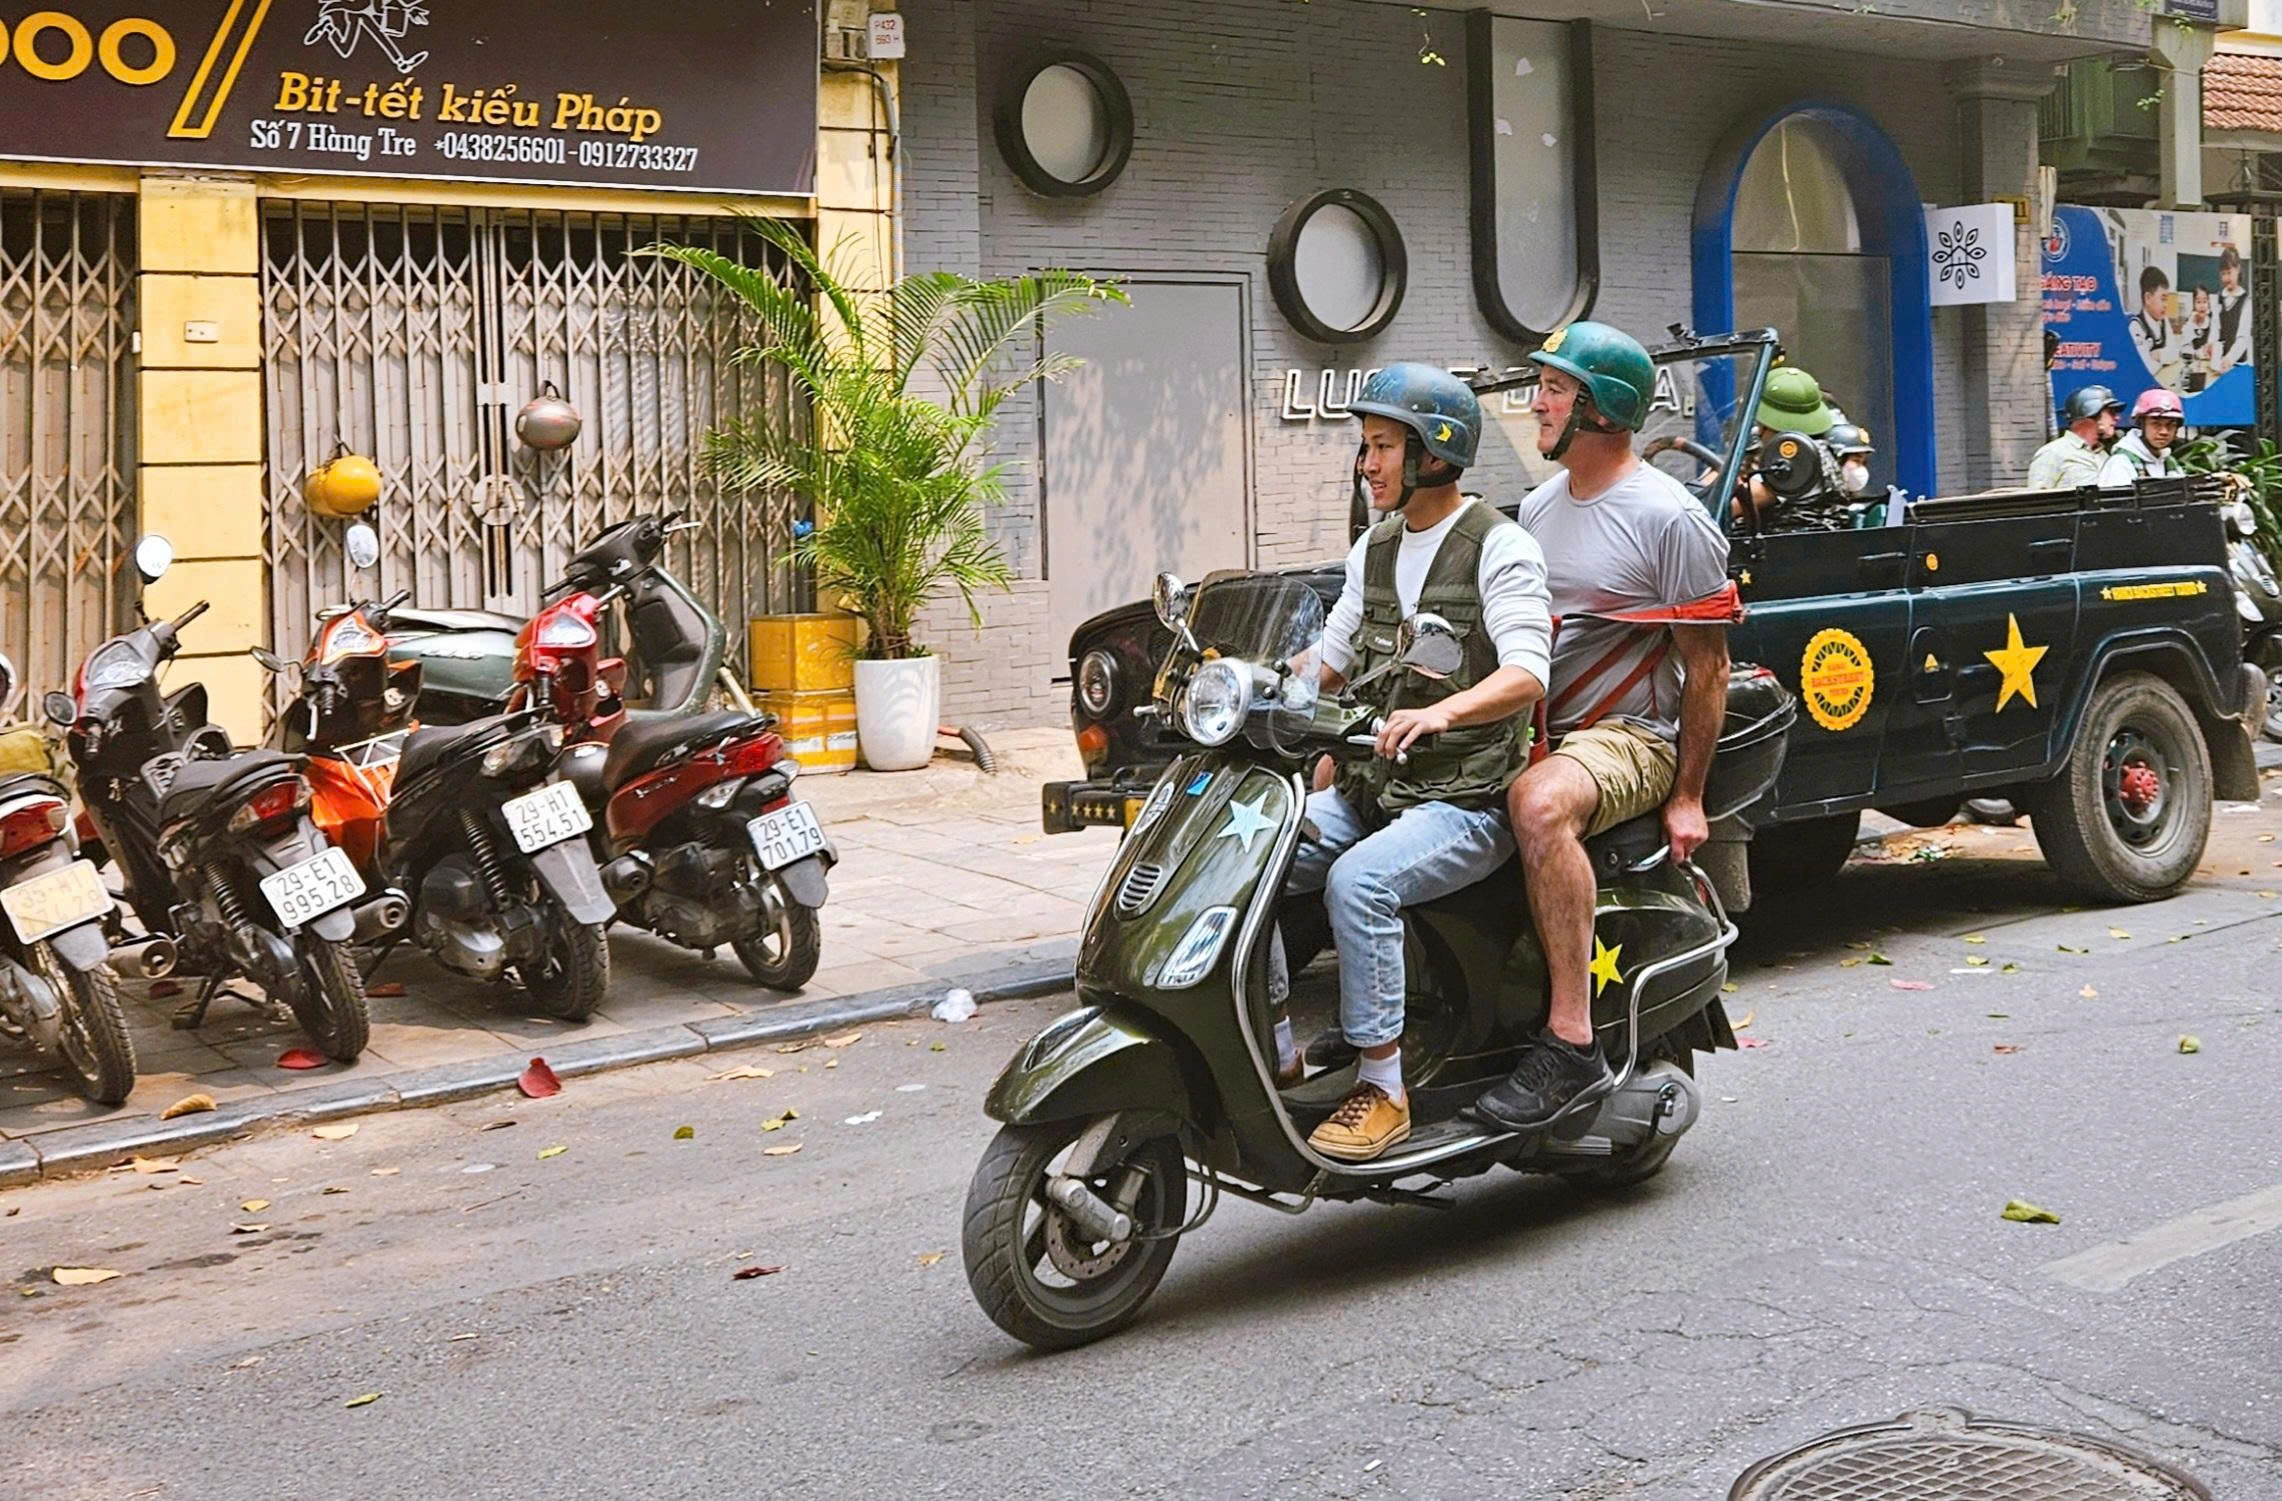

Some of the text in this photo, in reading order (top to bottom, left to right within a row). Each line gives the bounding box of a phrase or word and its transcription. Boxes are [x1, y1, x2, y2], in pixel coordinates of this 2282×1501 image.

[437, 83, 540, 128] kiểu
[551, 92, 662, 142] Pháp
[250, 119, 286, 149] Số
[287, 122, 302, 150] 7
[307, 123, 373, 161] Hàng
[378, 127, 416, 156] Tre
[515, 789, 569, 824] 29-H1
[759, 809, 807, 842] 29-E1
[520, 809, 584, 847] 554.51
[763, 827, 822, 866] 701.79
[277, 857, 337, 896] 29-E1
[283, 874, 355, 920] 995.28
